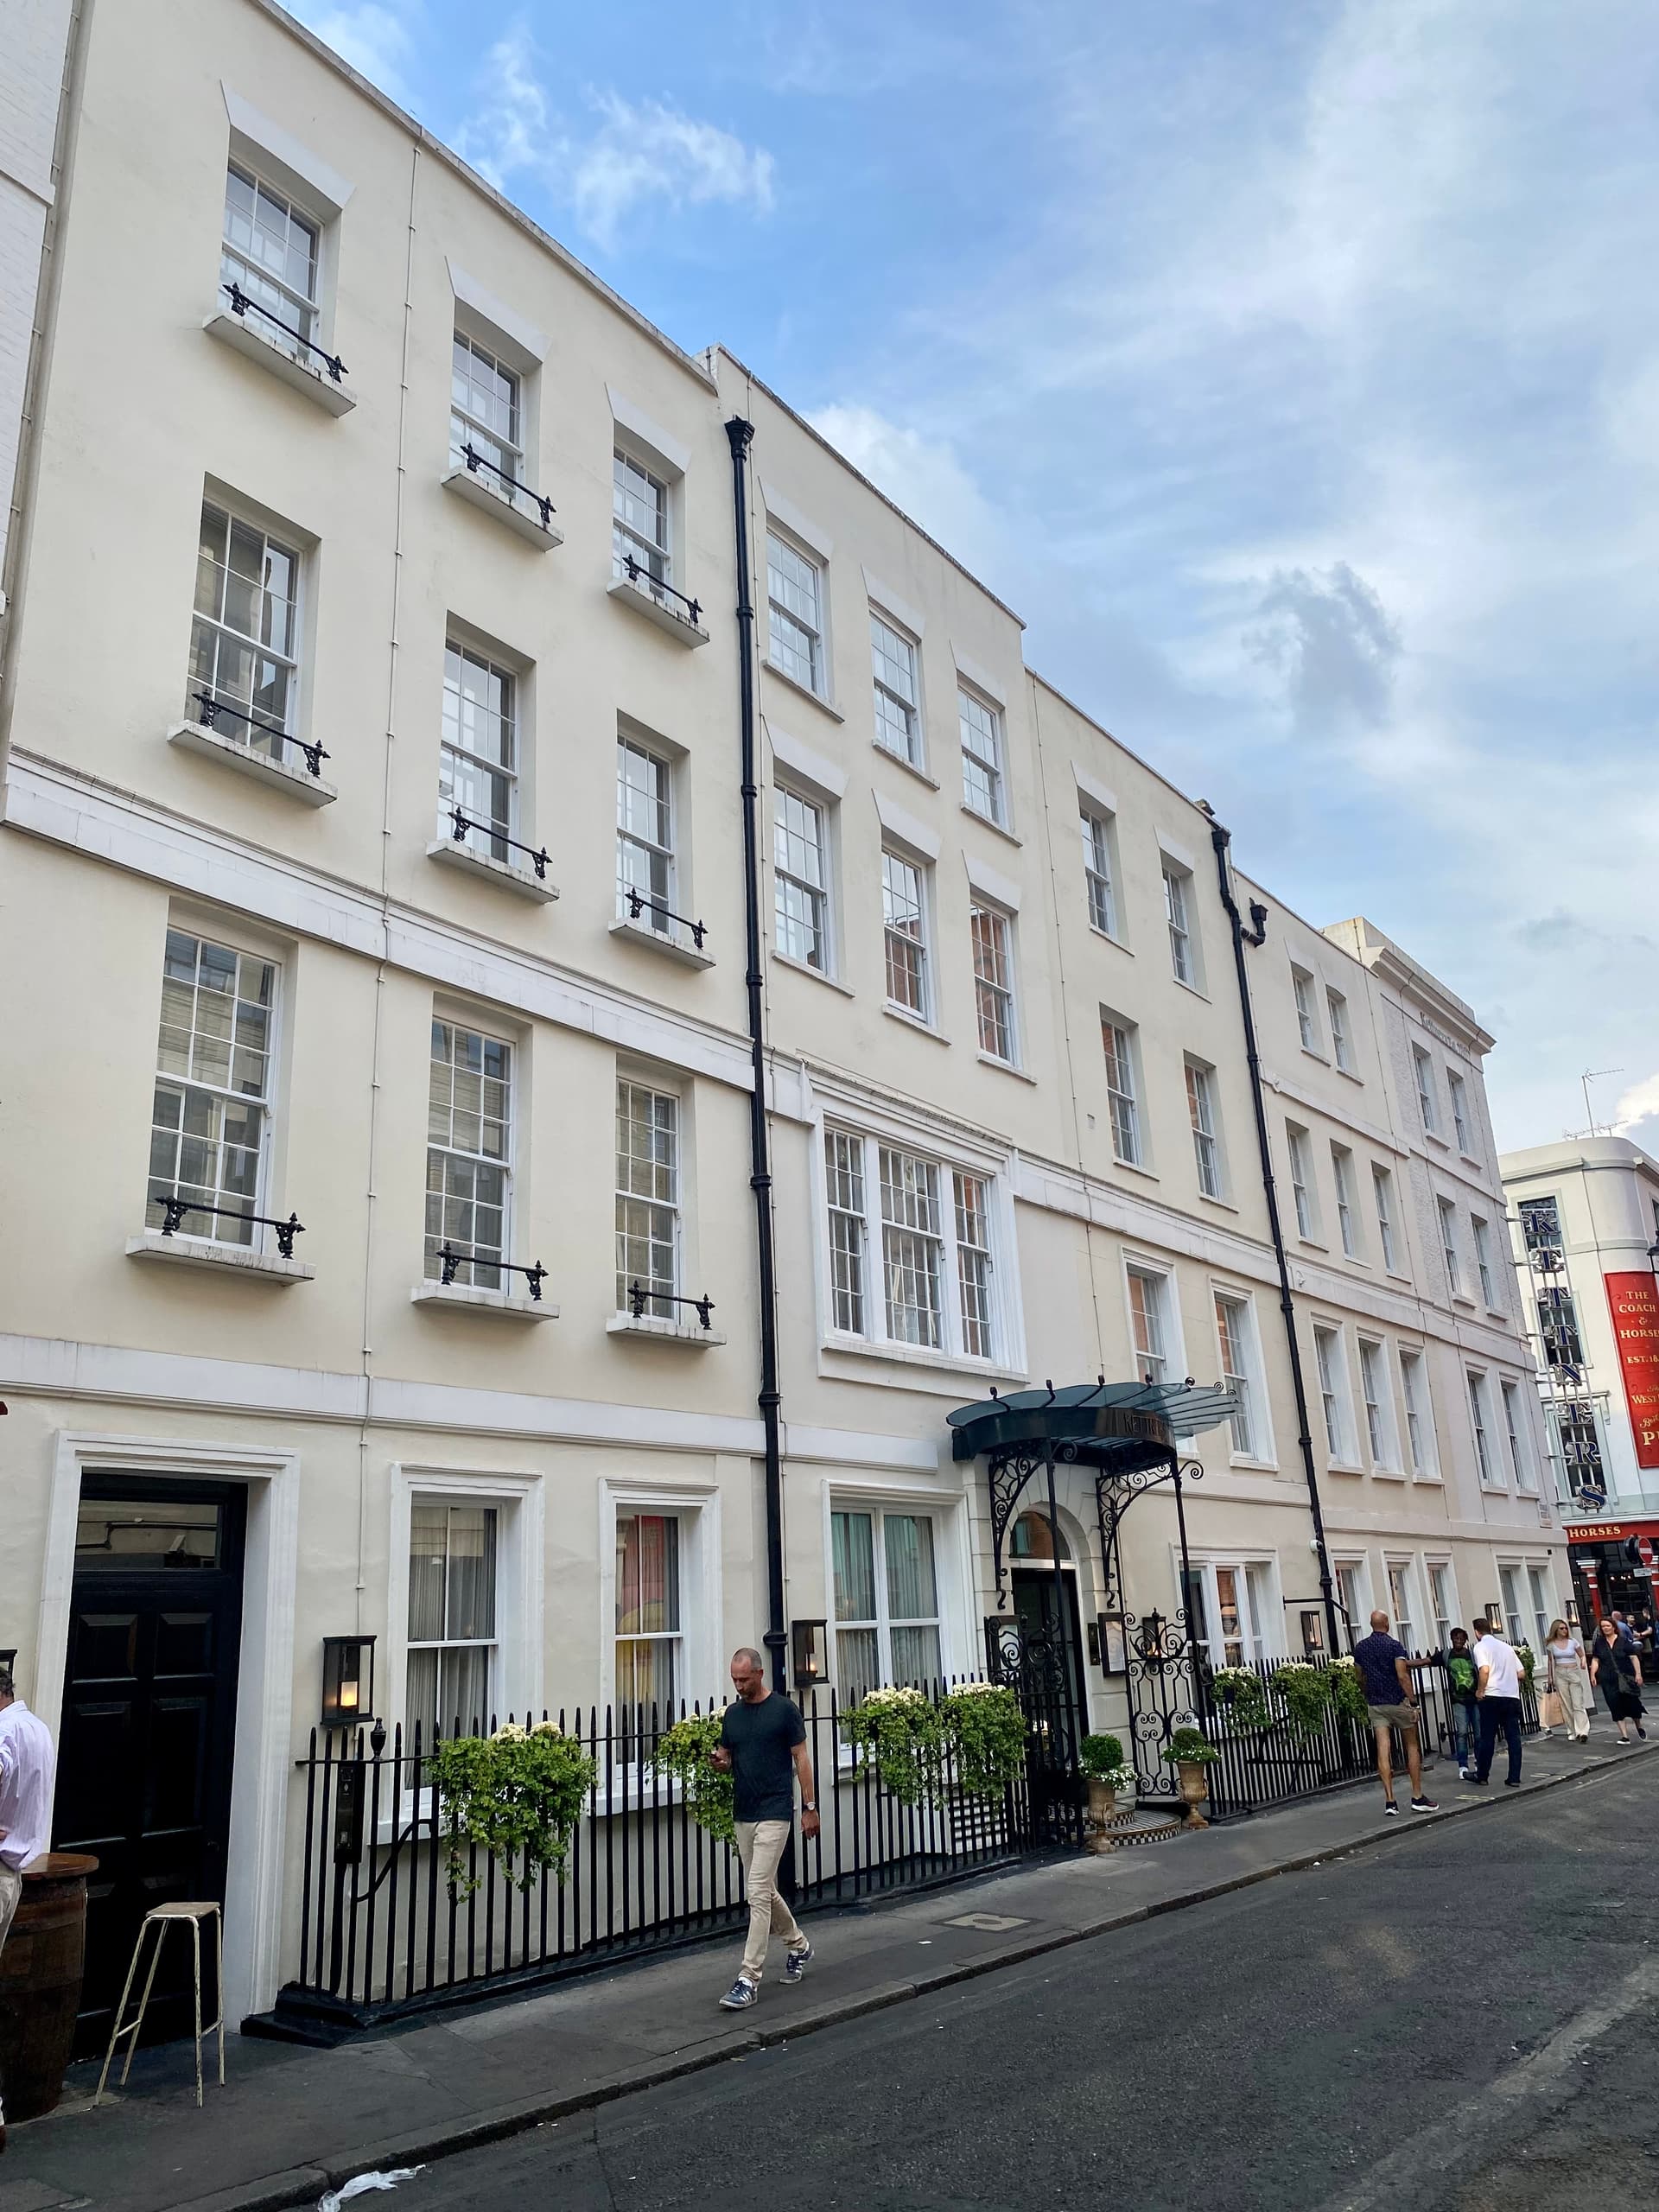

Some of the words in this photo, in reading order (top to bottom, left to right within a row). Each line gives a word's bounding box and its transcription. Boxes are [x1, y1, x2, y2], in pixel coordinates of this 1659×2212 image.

[1625, 1291, 1649, 1300] THE
[1618, 1304, 1656, 1313] COACH
[1638, 1316, 1648, 1325] &
[1523, 1211, 1606, 1509] KETTNERS
[1649, 1354, 1659, 1363] 18
[1568, 1525, 1622, 1538] HORSES
